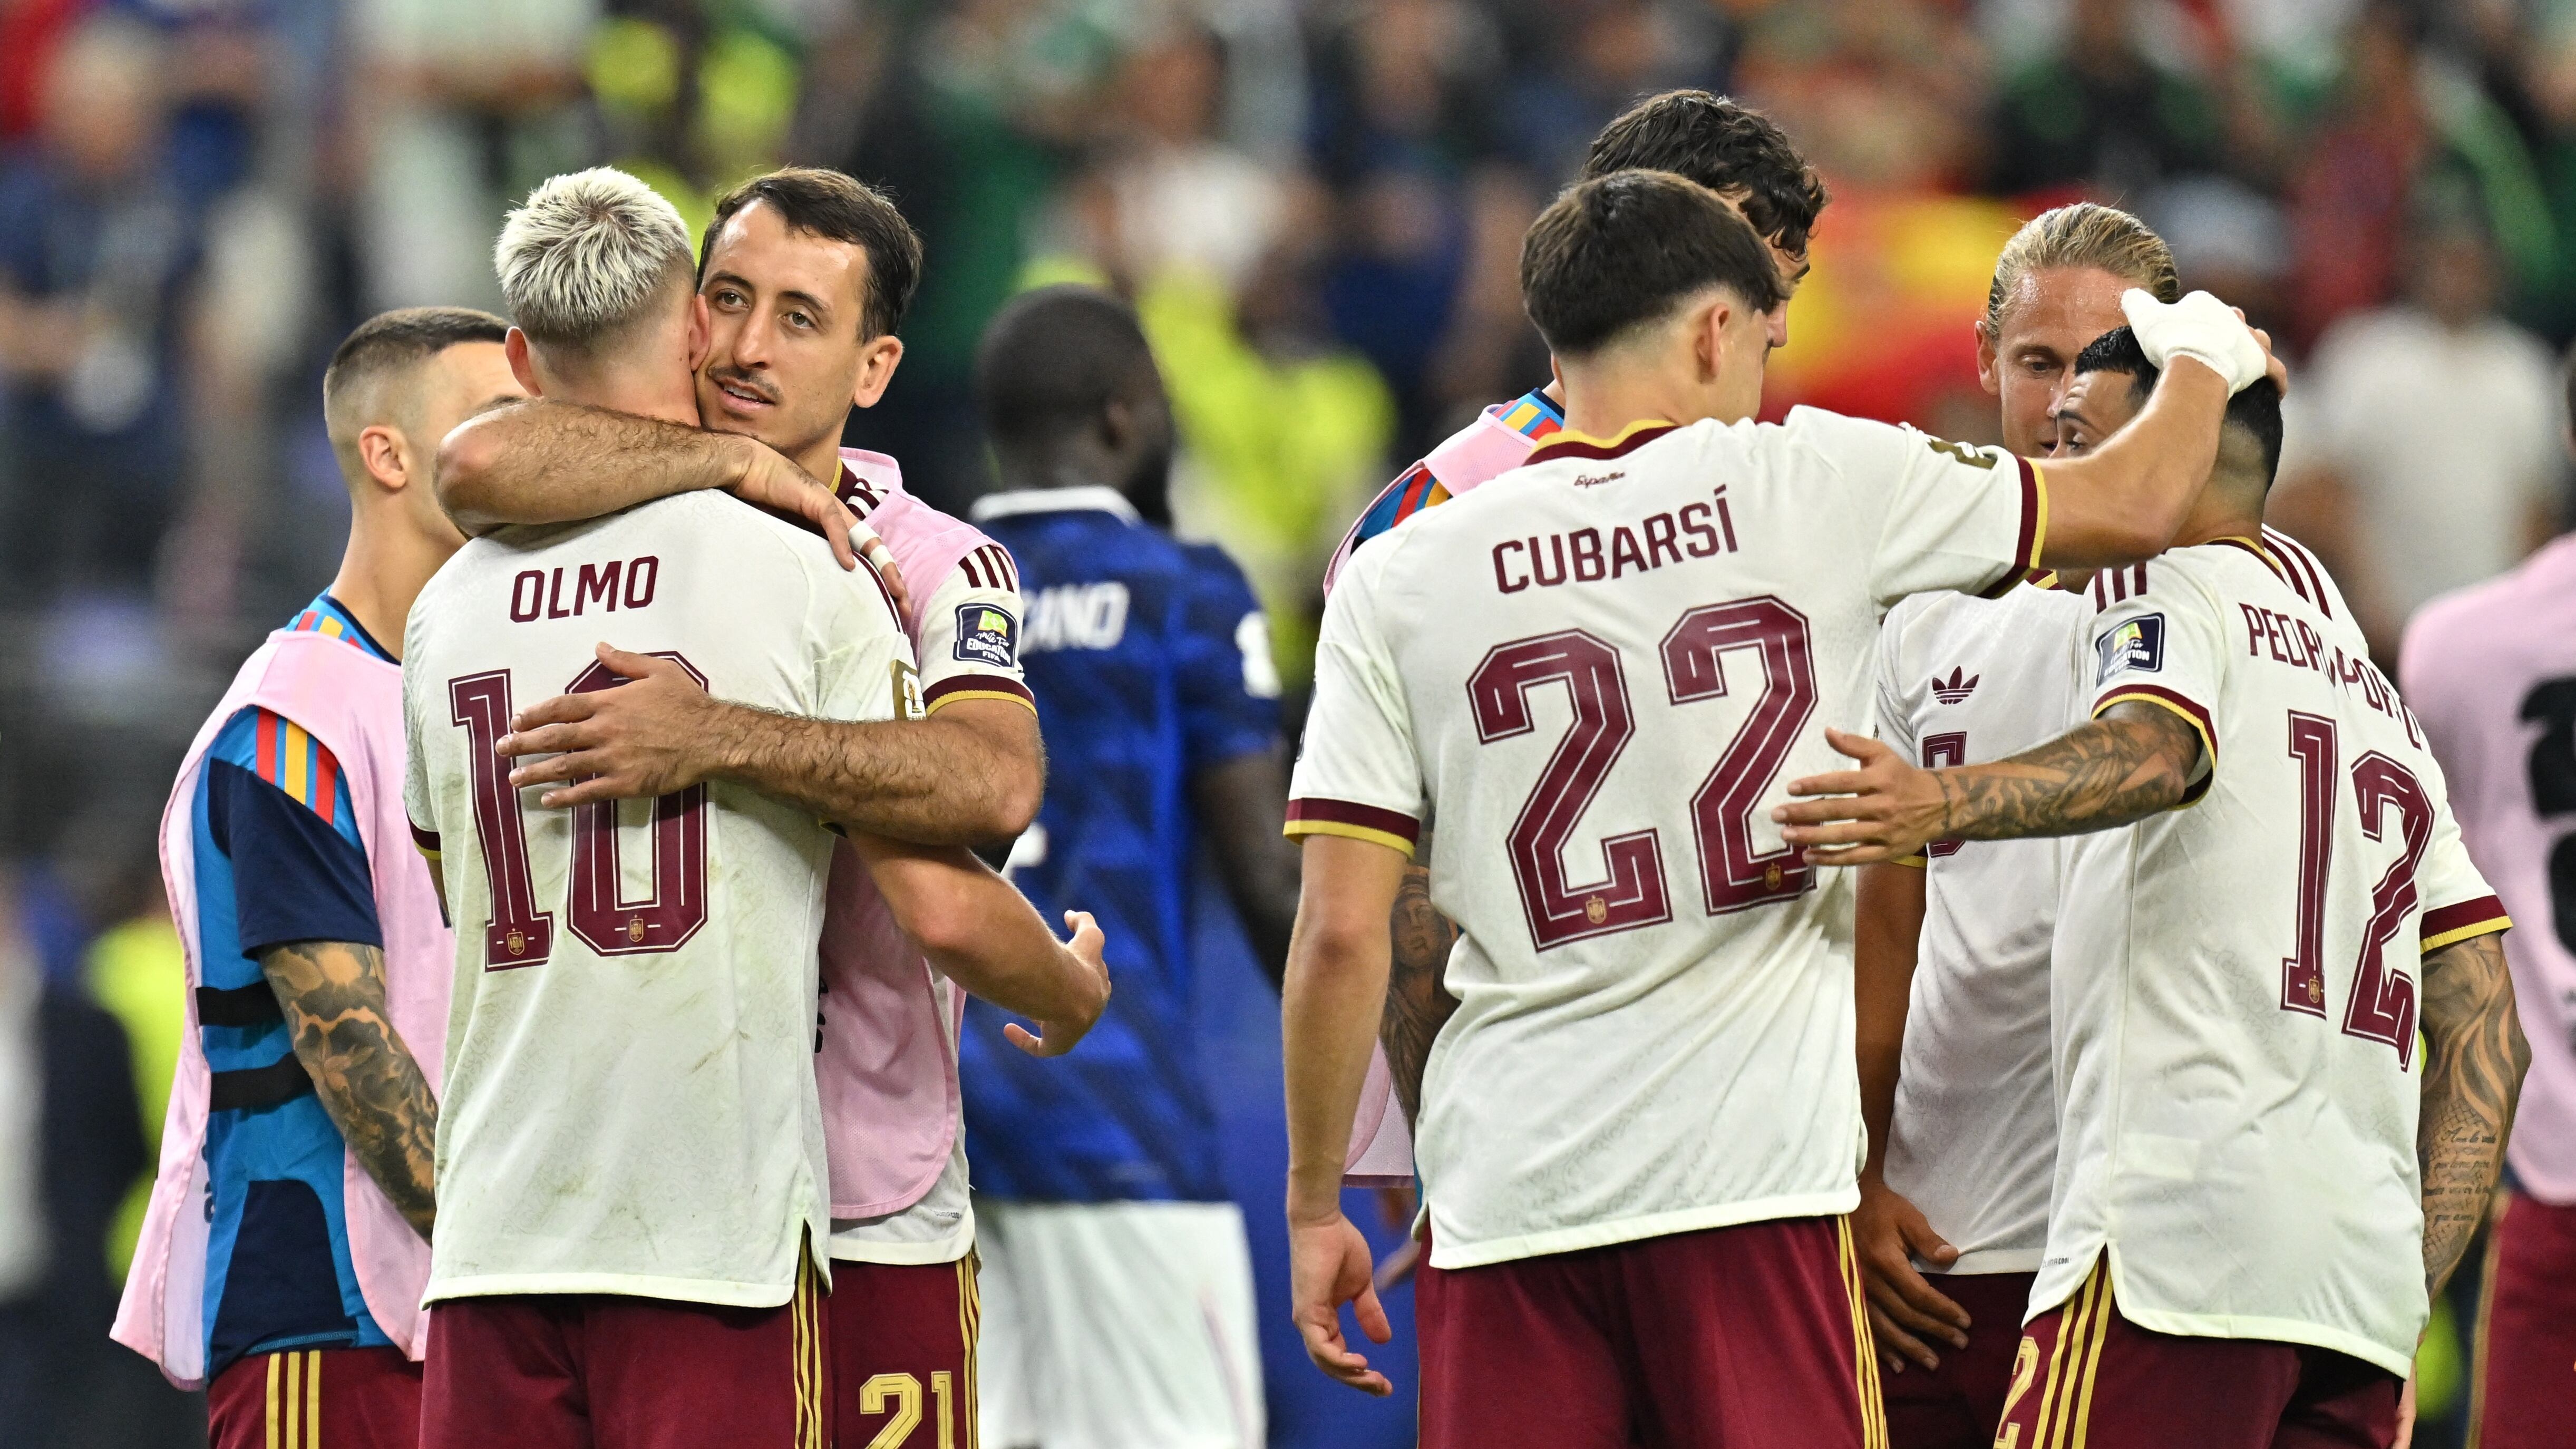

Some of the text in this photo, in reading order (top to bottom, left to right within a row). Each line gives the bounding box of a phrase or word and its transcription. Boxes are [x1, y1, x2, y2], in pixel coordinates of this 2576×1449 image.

[1492, 483, 1738, 595] CUBARSÍ
[510, 555, 659, 623] OLMO
[966, 637, 1011, 665] EDUCATION
[982, 650, 1002, 663] FIFA
[449, 650, 709, 973] 10
[1465, 594, 1819, 954] 22
[2280, 708, 2436, 1073] 12
[859, 1370, 956, 1449] 21
